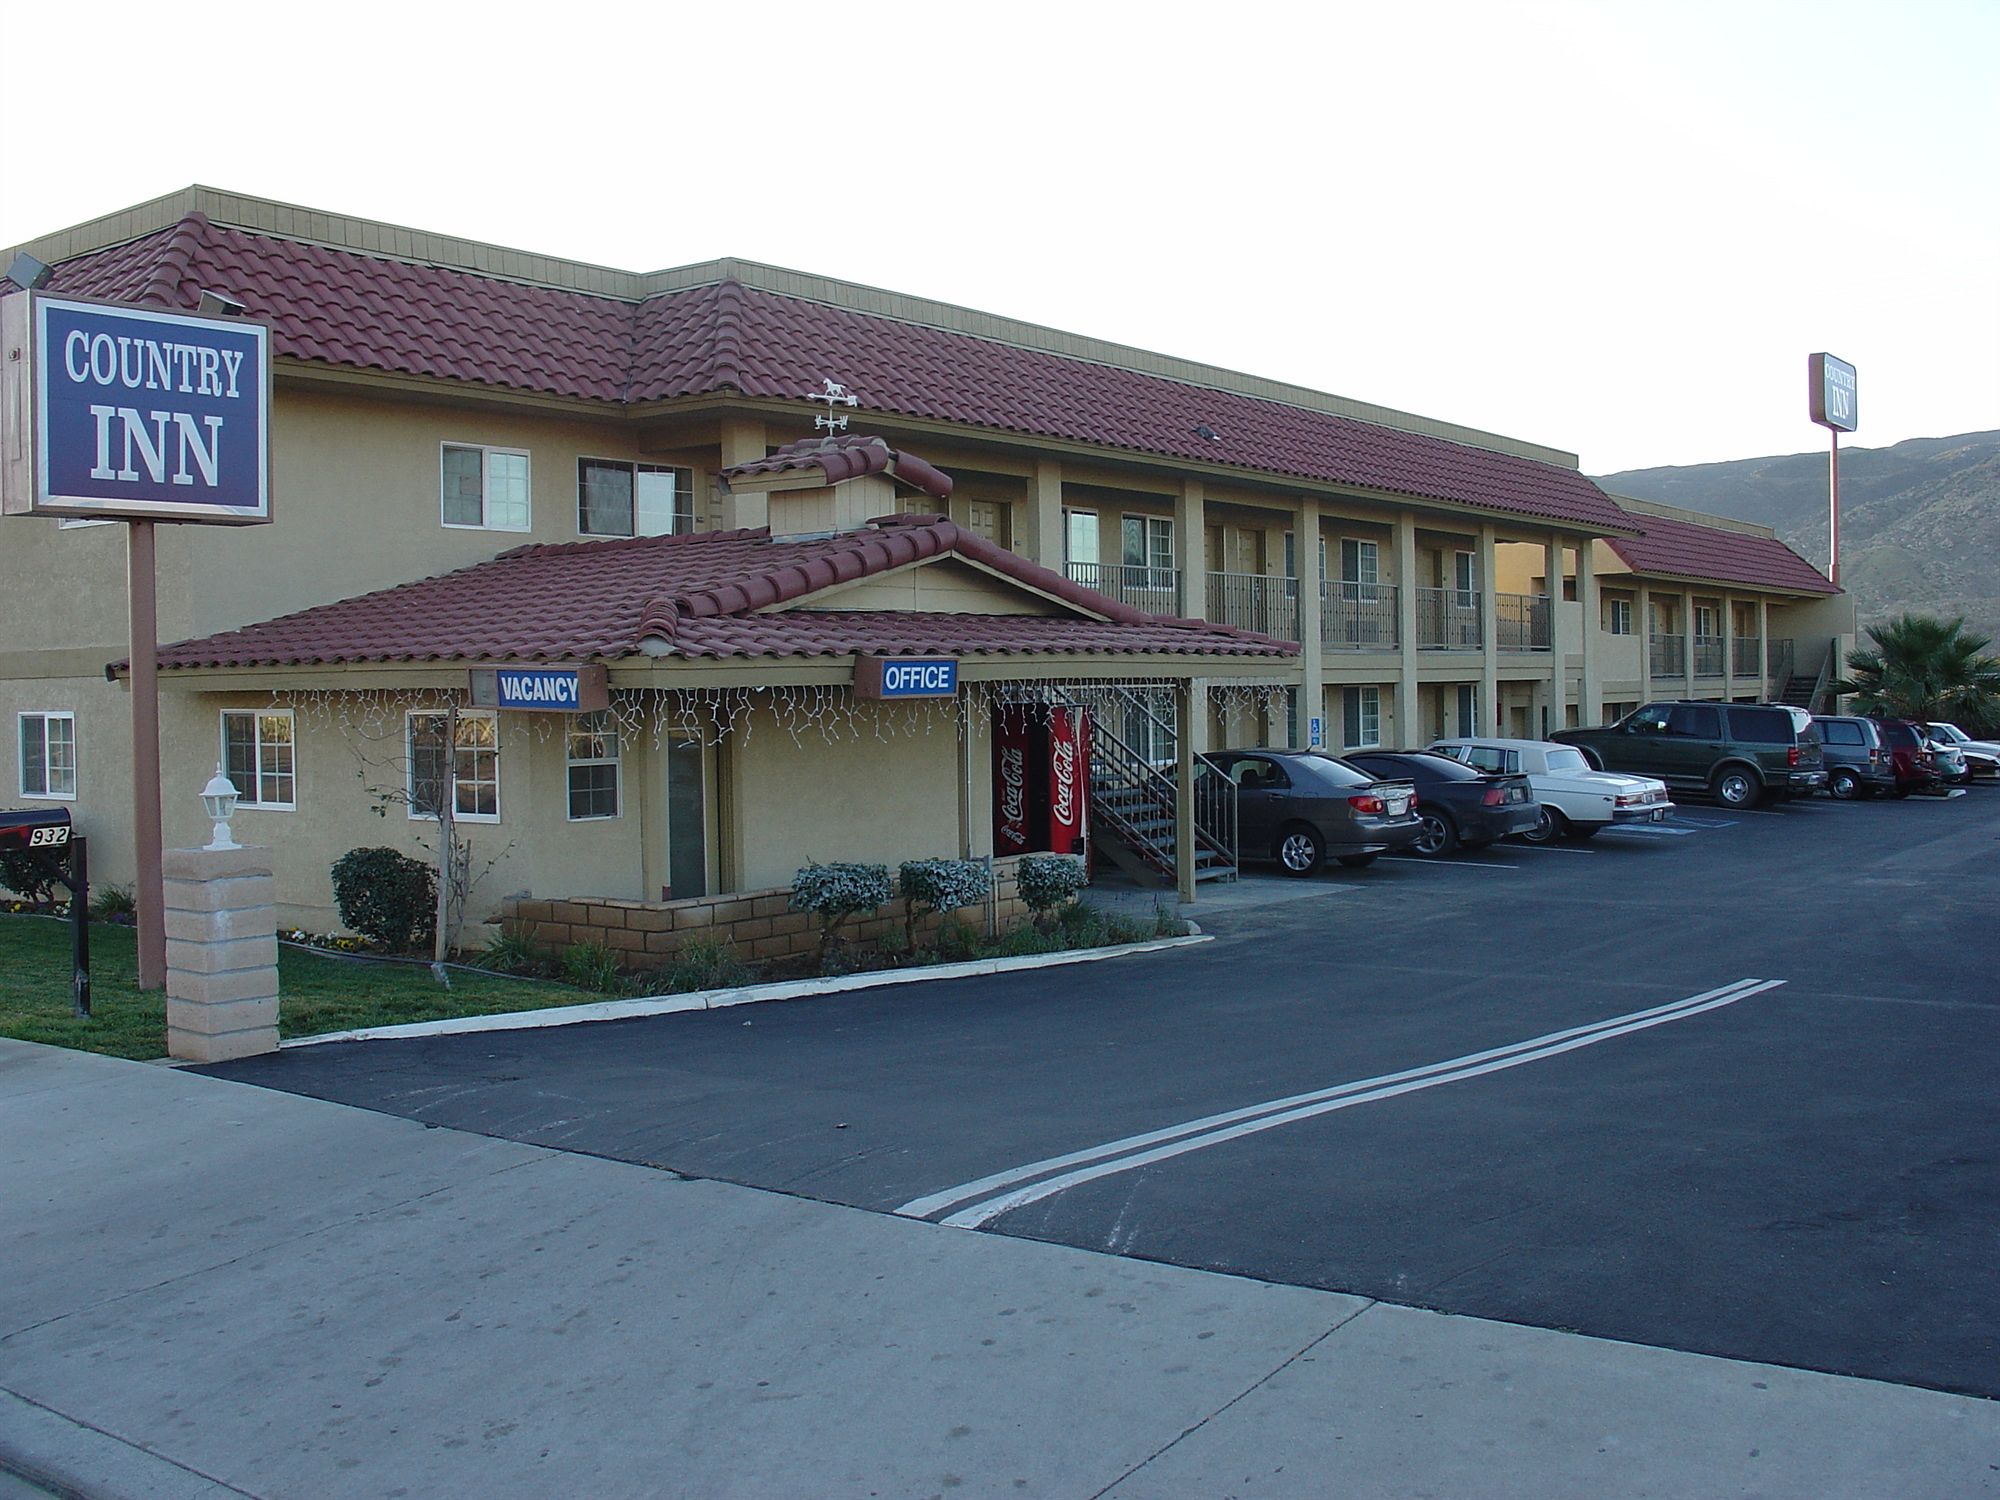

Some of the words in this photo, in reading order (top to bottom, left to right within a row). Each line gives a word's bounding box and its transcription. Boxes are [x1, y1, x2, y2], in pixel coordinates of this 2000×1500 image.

[65, 329, 244, 398] COUNTRY
[1832, 385, 1849, 419] INN
[90, 404, 223, 487] INN
[501, 676, 578, 702] VACANCY
[885, 666, 950, 690] OFFICE
[32, 827, 67, 845] 932
